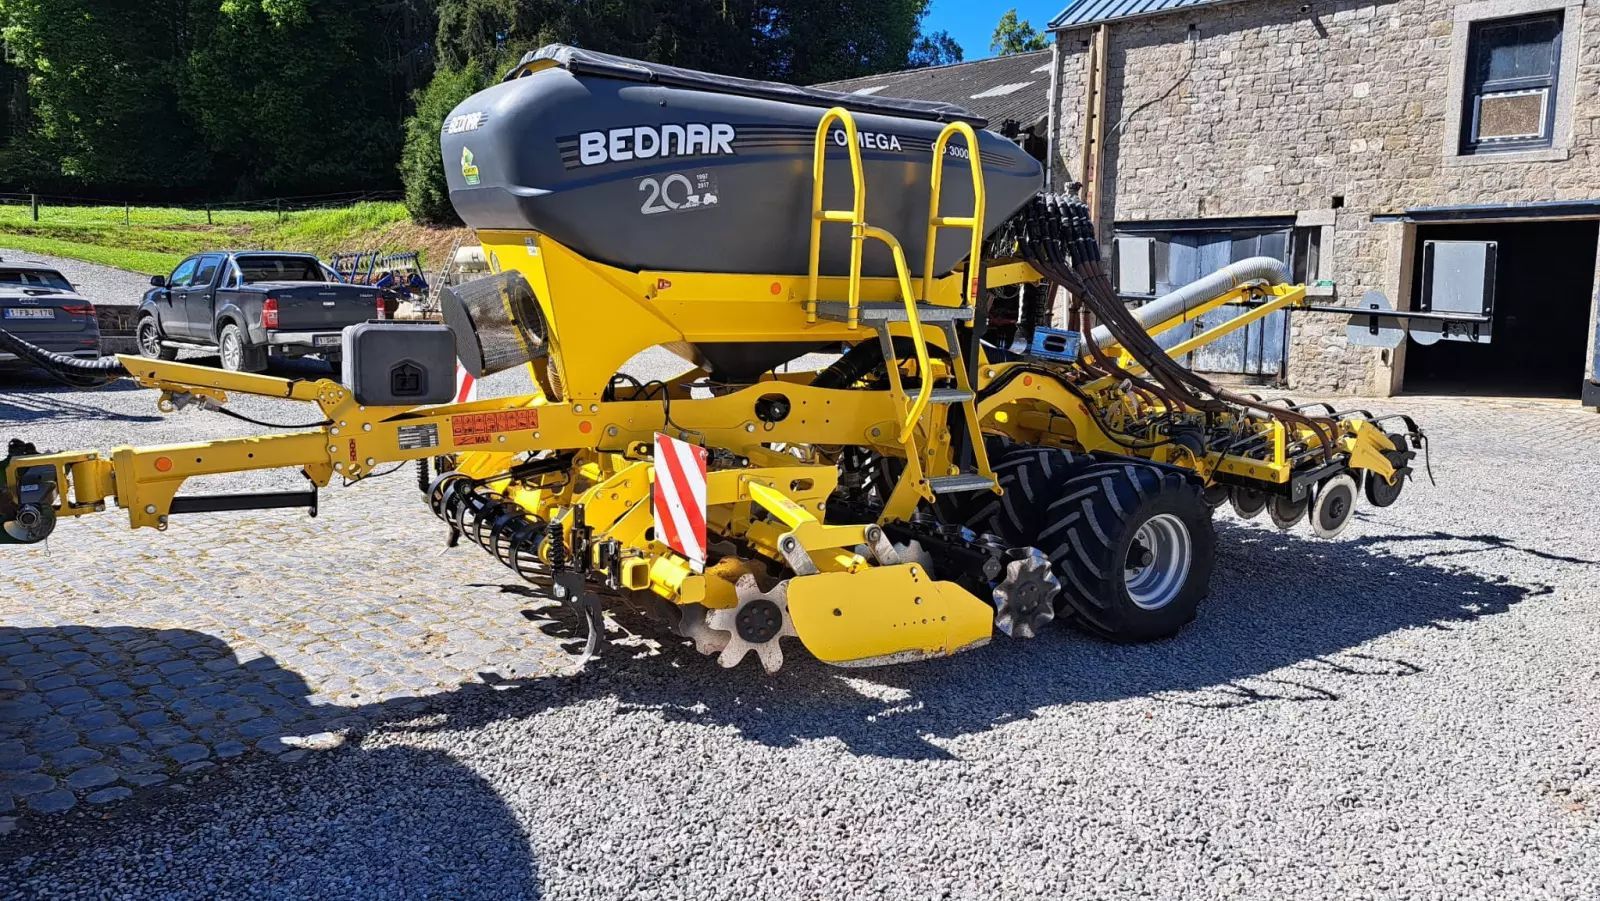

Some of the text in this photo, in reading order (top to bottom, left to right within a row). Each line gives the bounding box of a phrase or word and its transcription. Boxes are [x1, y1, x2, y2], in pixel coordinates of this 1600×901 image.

[580, 123, 735, 166] BEDNAR
[949, 145, 969, 159] 3000
[639, 173, 694, 215] 20
